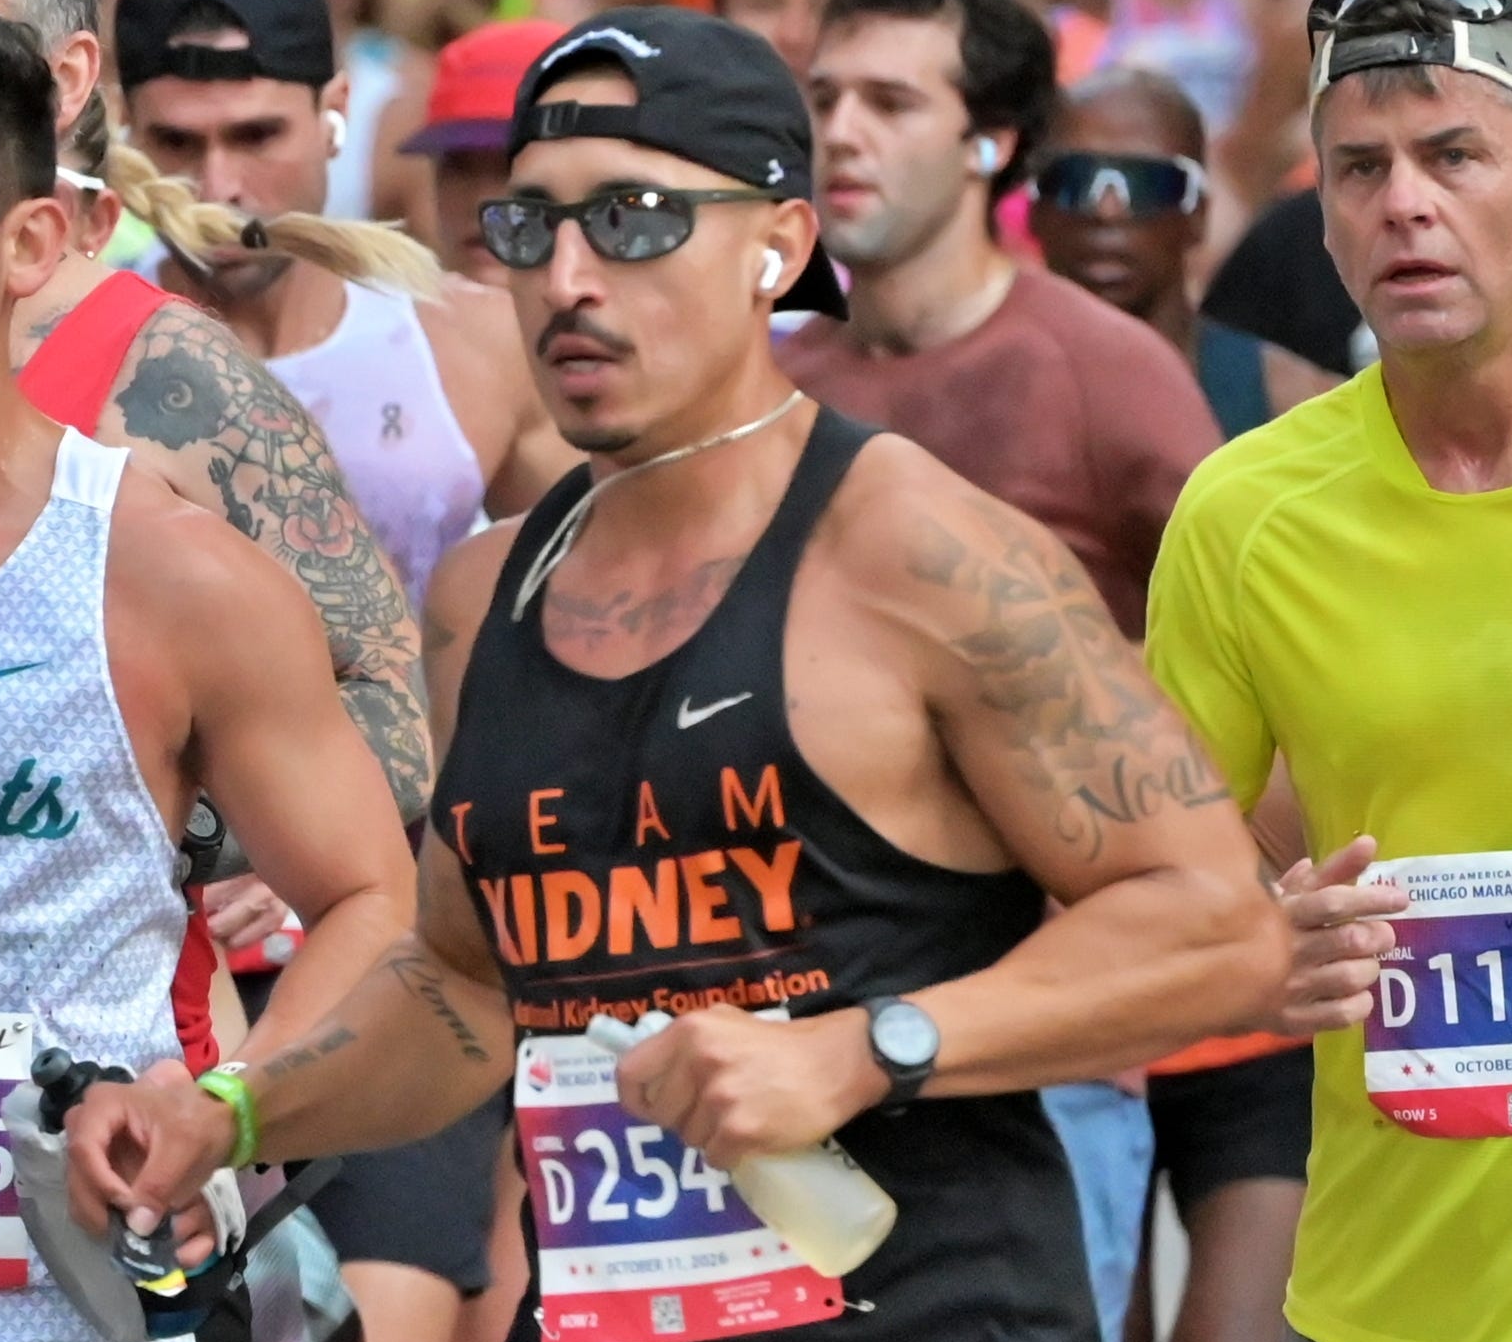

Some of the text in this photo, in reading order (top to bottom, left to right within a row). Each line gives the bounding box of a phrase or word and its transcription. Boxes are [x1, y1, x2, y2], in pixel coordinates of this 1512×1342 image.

[450, 763, 786, 865] TEAM
[1407, 870, 1512, 884] BANK OF AMERICA
[1408, 887, 1468, 902] CHICAGO
[479, 840, 802, 966] KIDNEY
[1379, 968, 1417, 1028] D
[1393, 1108, 1437, 1123] ROW 5
[539, 1158, 575, 1225] D
[575, 1125, 730, 1222] 254
[606, 1259, 664, 1276] OCTOBER
